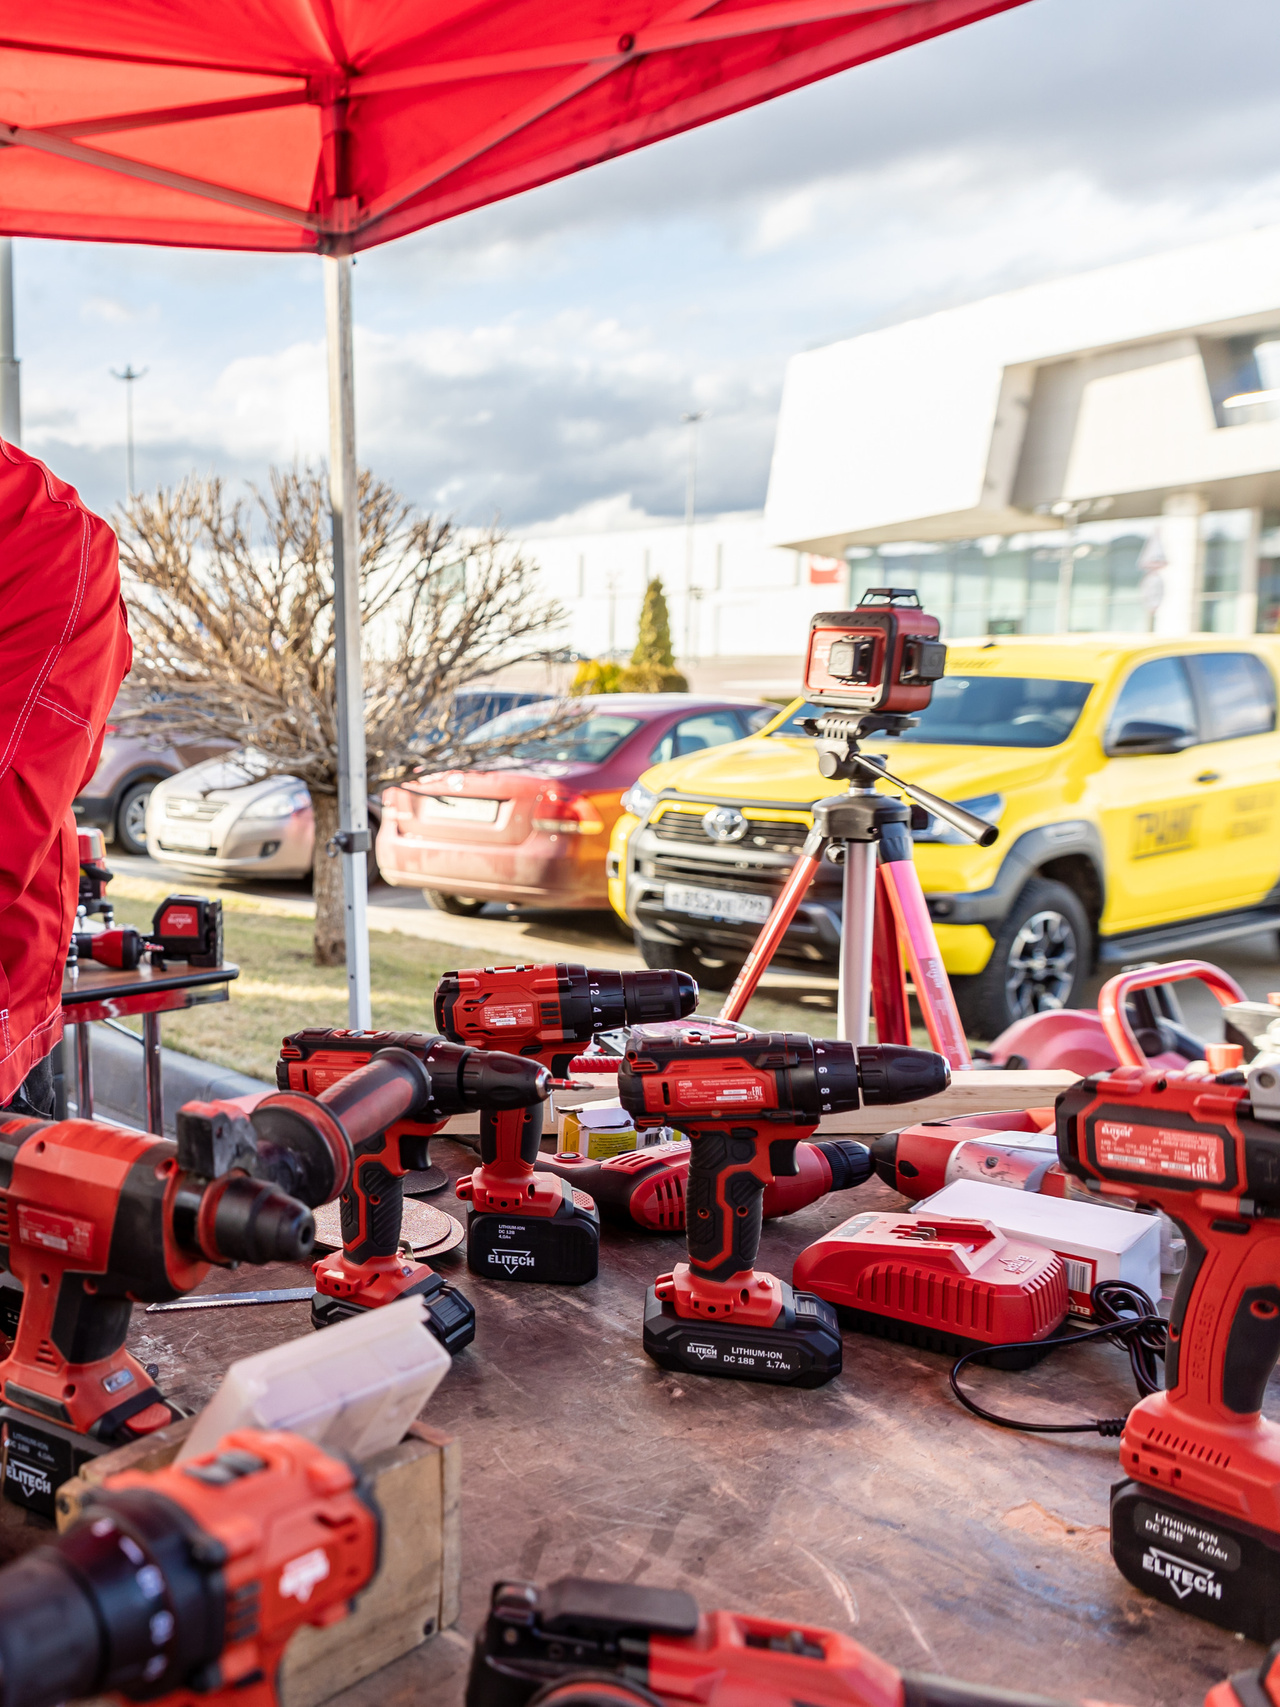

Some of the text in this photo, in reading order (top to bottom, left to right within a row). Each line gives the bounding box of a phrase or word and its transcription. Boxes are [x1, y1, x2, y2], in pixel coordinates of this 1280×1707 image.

[815, 1047, 826, 1055] 4
[818, 1066, 828, 1074] 6
[820, 1087, 831, 1095] 8
[487, 1254, 535, 1267] ELITECH
[687, 1346, 718, 1356] ELITECH
[731, 1347, 783, 1360] LITHIUM-ION
[723, 1355, 736, 1363] DC
[6, 1464, 52, 1495] ELITECH
[1145, 1519, 1160, 1534] DC
[1154, 1512, 1219, 1546] LITHIUM-ION
[1142, 1552, 1223, 1601] ELITECH
